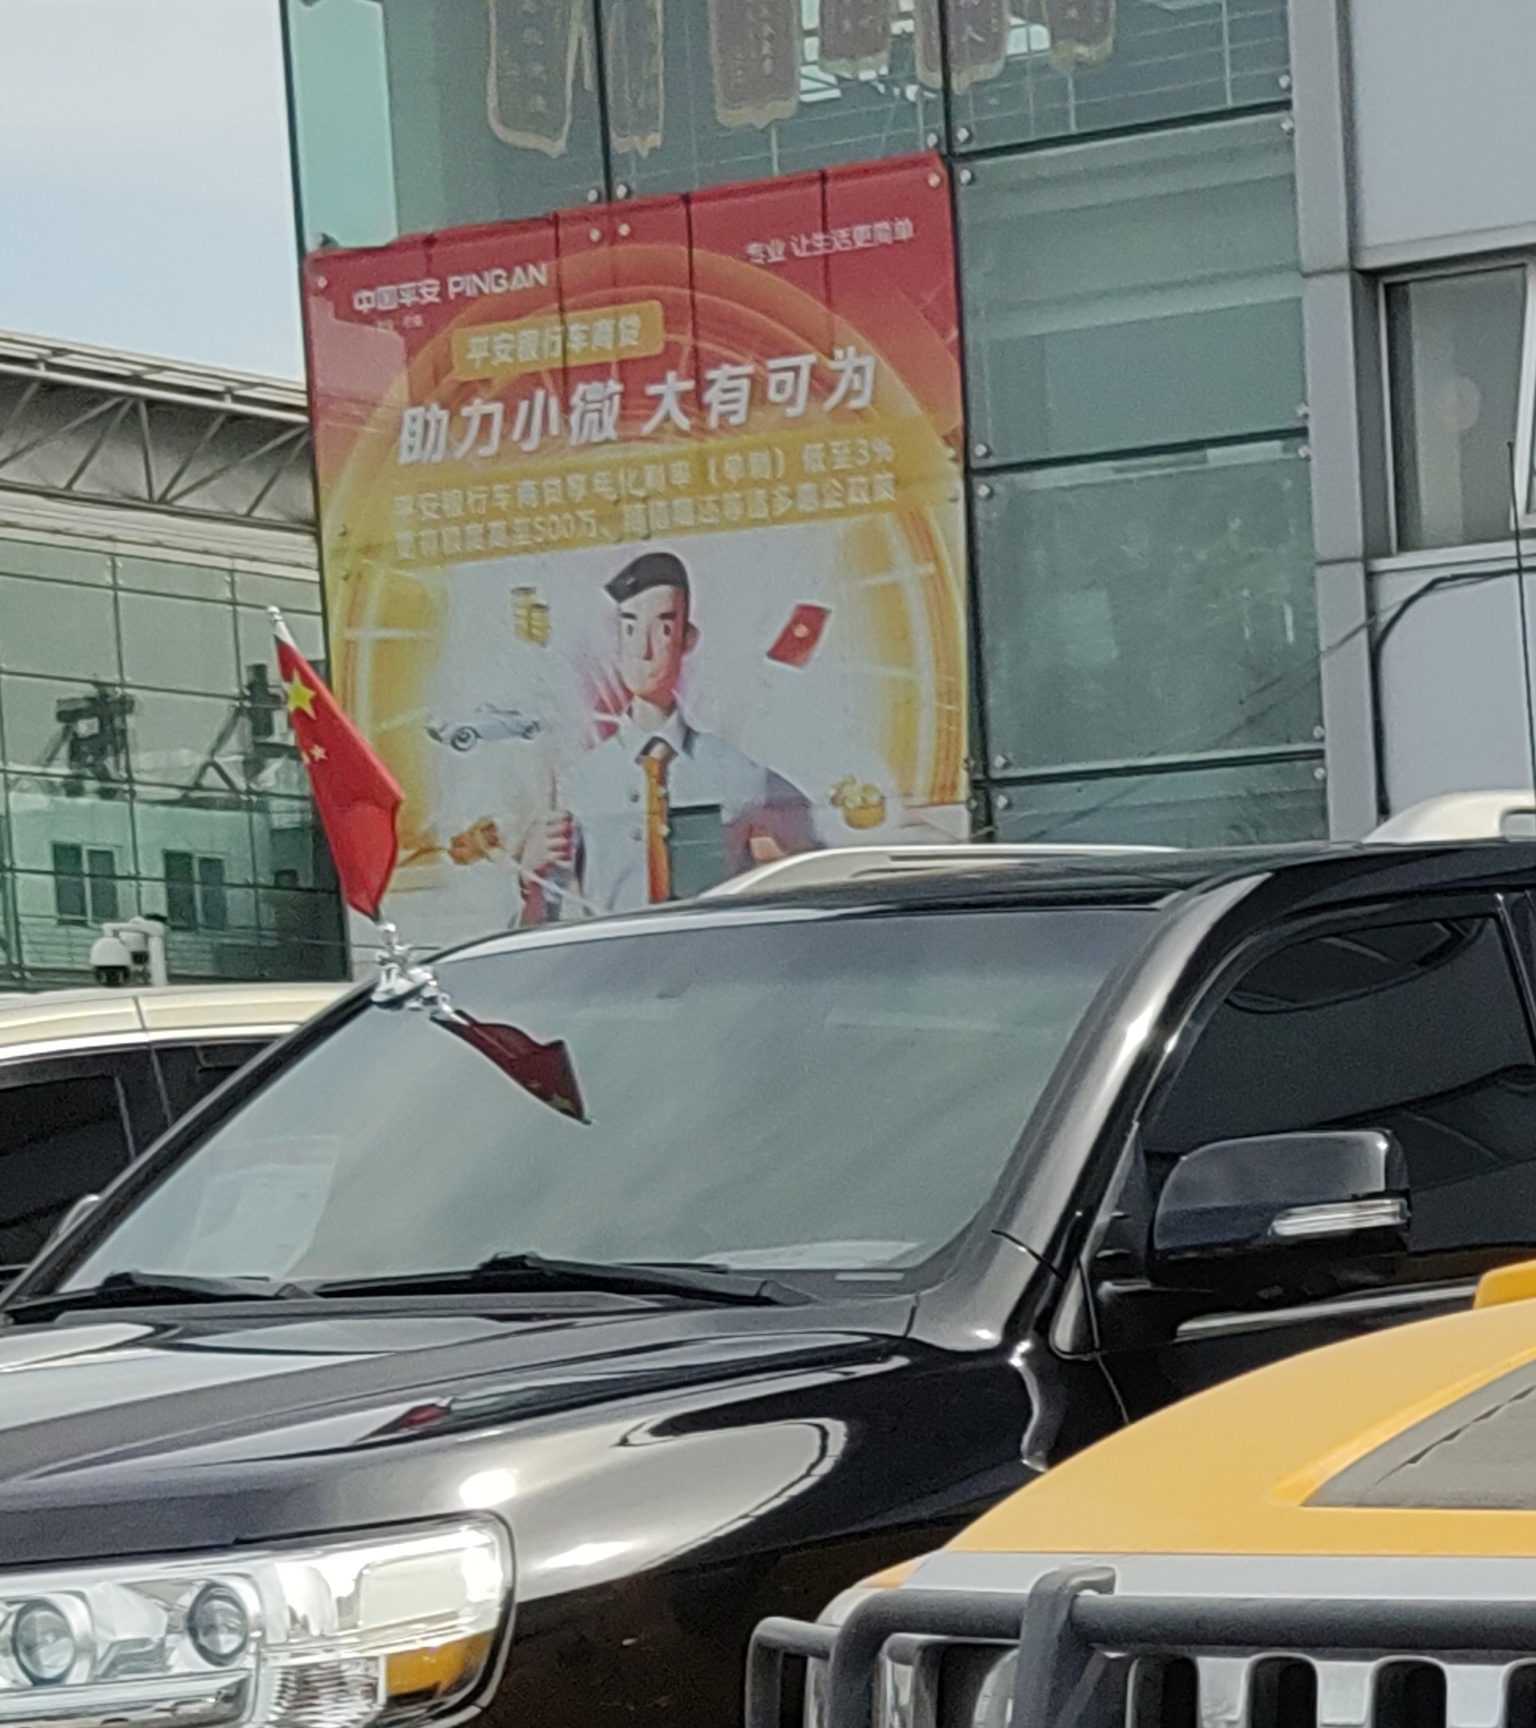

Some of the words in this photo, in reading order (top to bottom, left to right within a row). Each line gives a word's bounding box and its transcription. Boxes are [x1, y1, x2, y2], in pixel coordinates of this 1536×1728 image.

[353, 278, 441, 314] 中国平安
[447, 261, 549, 299] PINGAN
[397, 377, 625, 466] 助力小微
[640, 346, 877, 436] 大有可为
